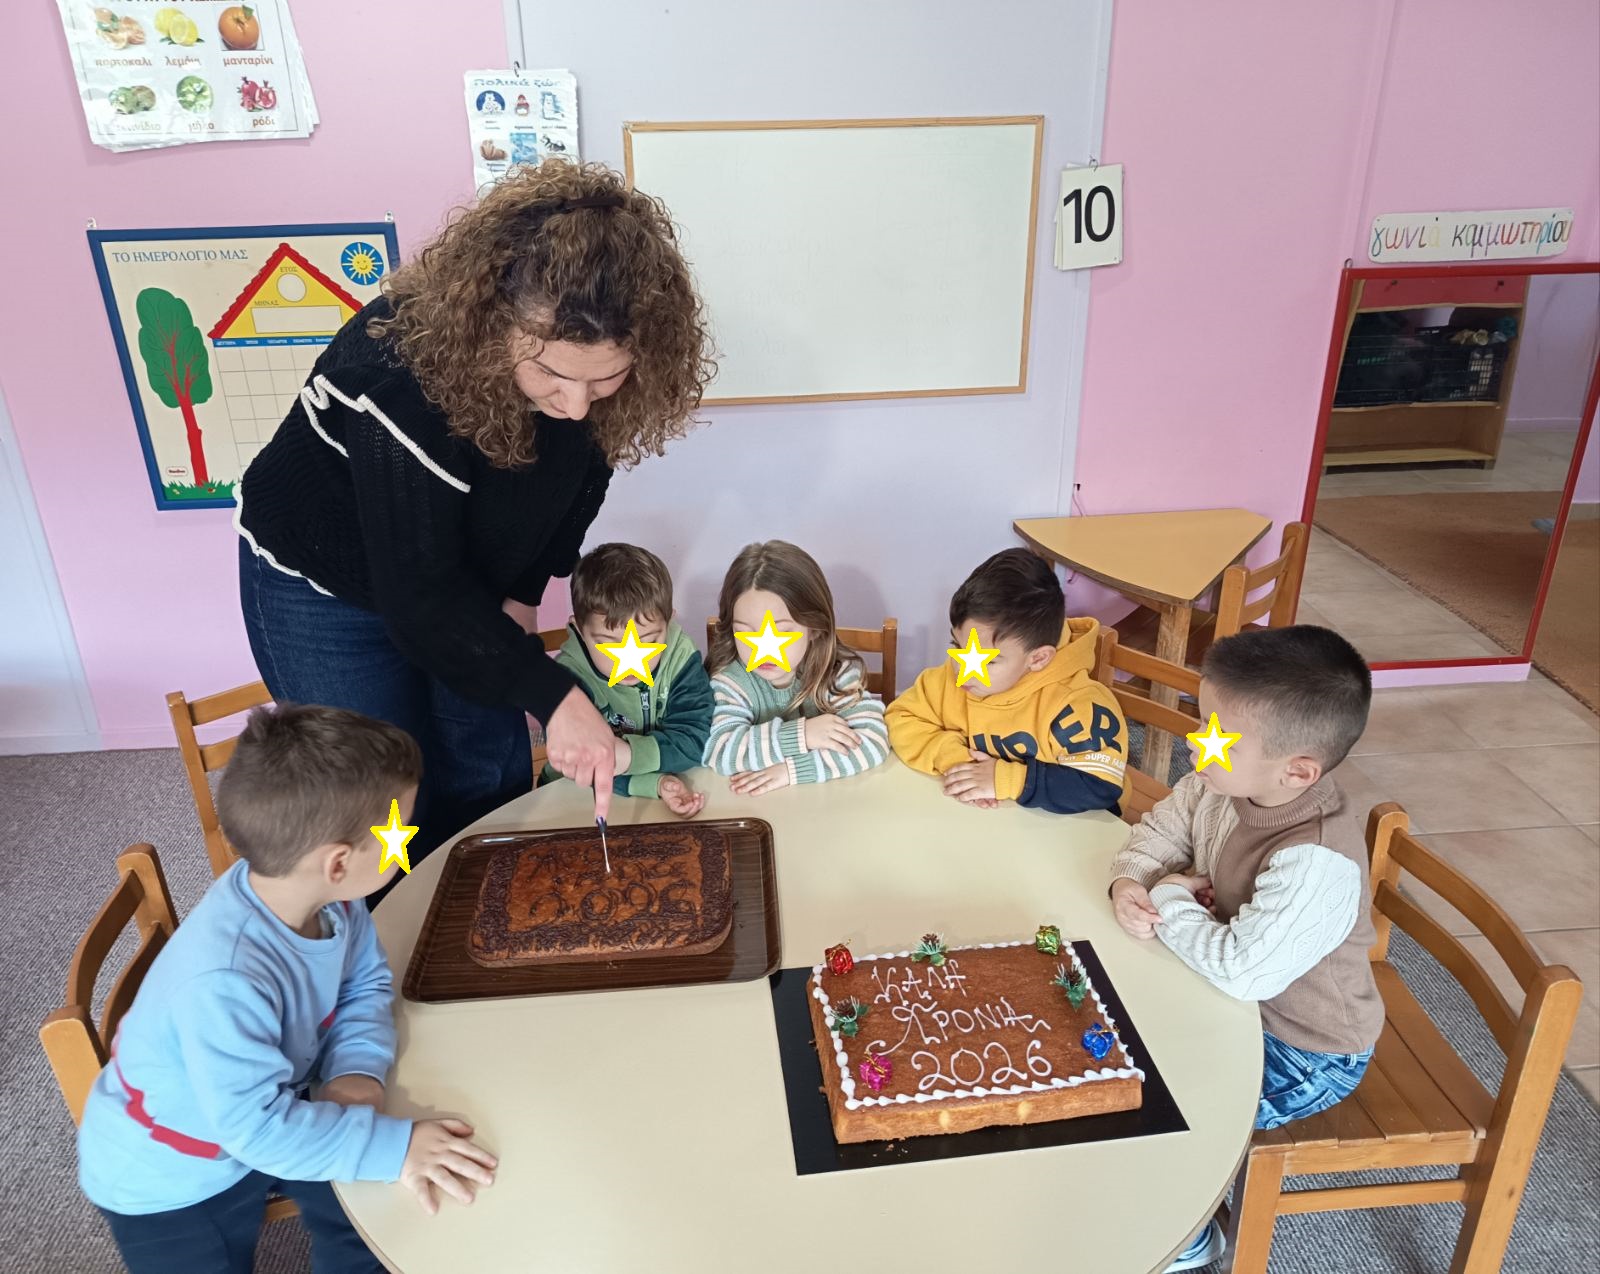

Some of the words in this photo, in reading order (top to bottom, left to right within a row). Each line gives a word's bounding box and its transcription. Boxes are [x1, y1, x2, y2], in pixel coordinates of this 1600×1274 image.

[223, 54, 275, 67] μανταρίνι
[534, 78, 561, 88] ζώ
[252, 115, 276, 129] ρόδι
[1063, 185, 1116, 244] 10
[1371, 216, 1442, 257] γωνιά
[111, 251, 132, 263] ΤΟ
[132, 250, 217, 263] ΗΜΕΡΟΛΟΓΙΟ
[219, 249, 249, 260] ΜΑΣ
[911, 1040, 1052, 1090] 2026
